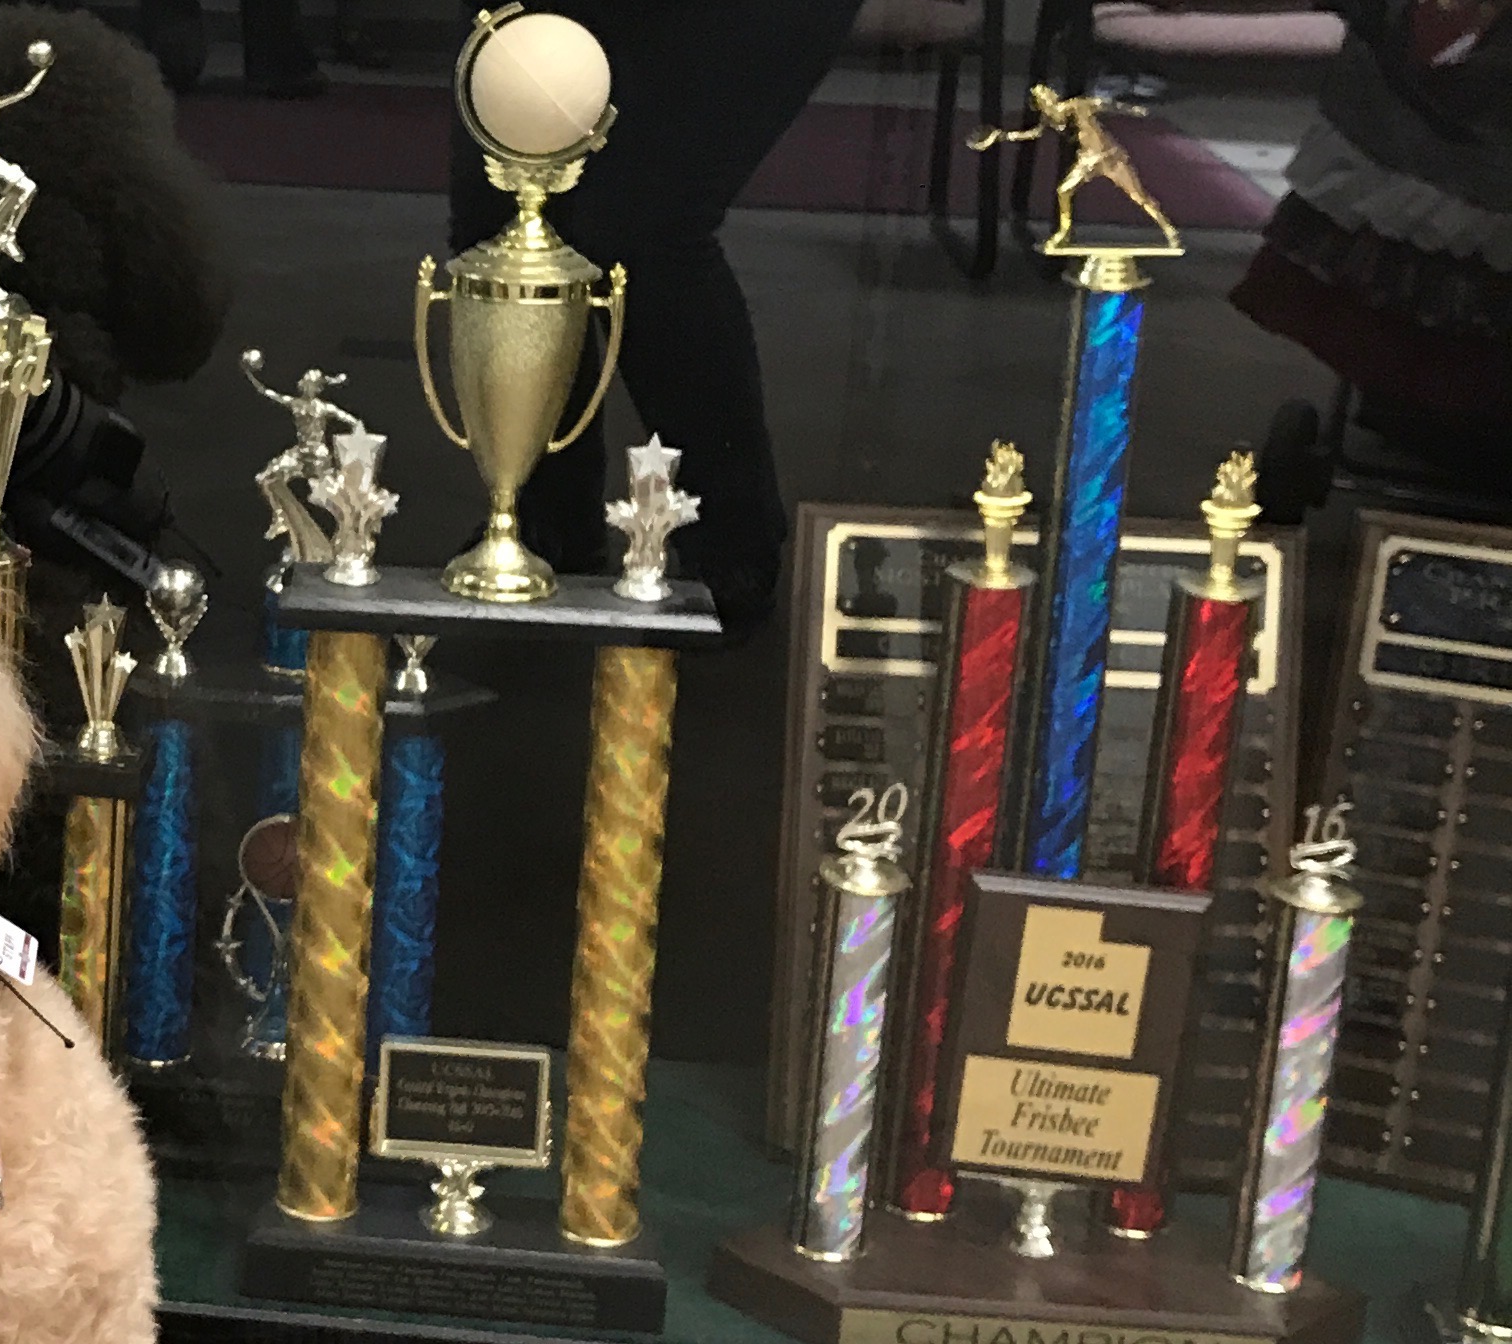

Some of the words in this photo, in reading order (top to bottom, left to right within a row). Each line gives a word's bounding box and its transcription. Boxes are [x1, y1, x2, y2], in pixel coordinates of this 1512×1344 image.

[845, 782, 909, 826] 20
[1060, 950, 1108, 971] 2016
[1023, 981, 1131, 1017] UCSSAL
[1009, 1067, 1113, 1107] Ultimate
[1009, 1100, 1102, 1139] Frisbee
[979, 1127, 1124, 1172] Tournament
